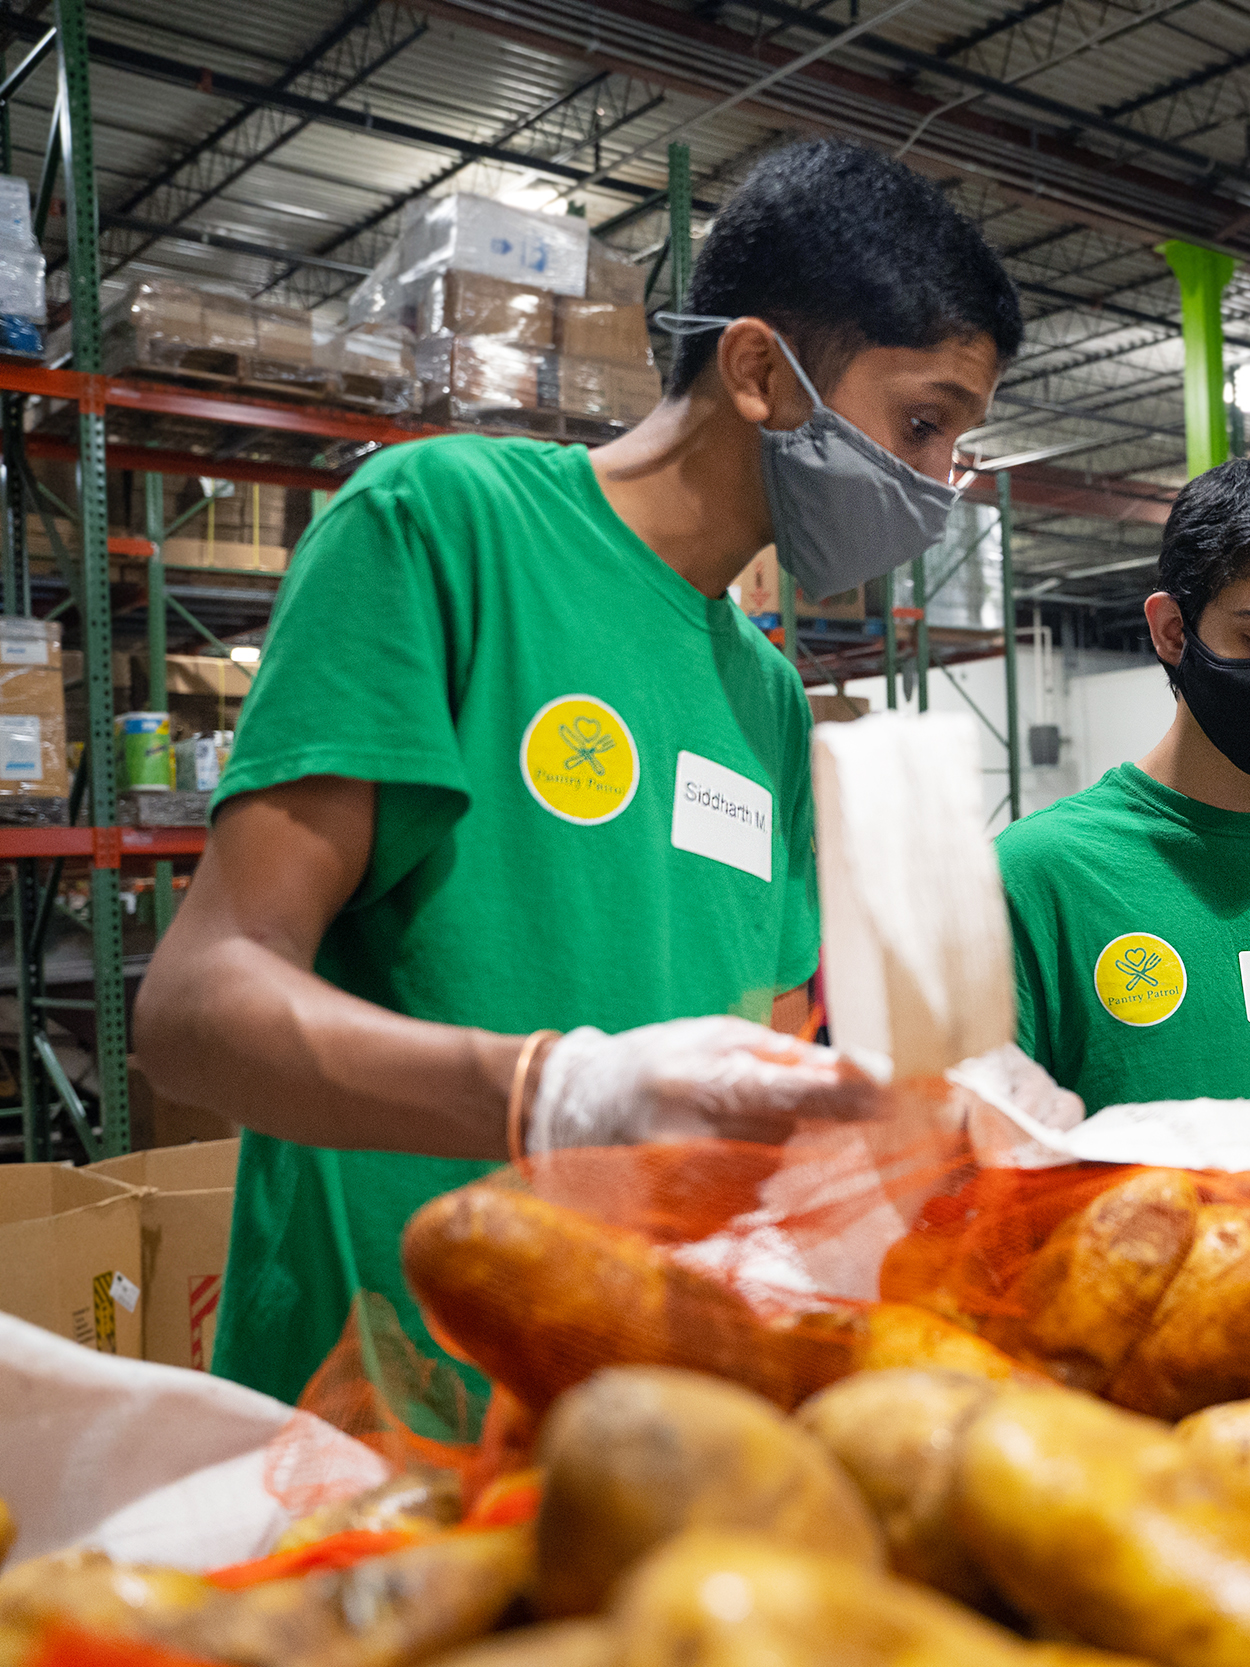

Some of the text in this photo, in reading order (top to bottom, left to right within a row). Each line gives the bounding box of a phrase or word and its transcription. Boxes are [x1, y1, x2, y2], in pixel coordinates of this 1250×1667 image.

[535, 767, 626, 797] Pantry Patrol
[685, 781, 768, 834] Siddharth M.
[1107, 985, 1180, 1007] Pantry Patrol
